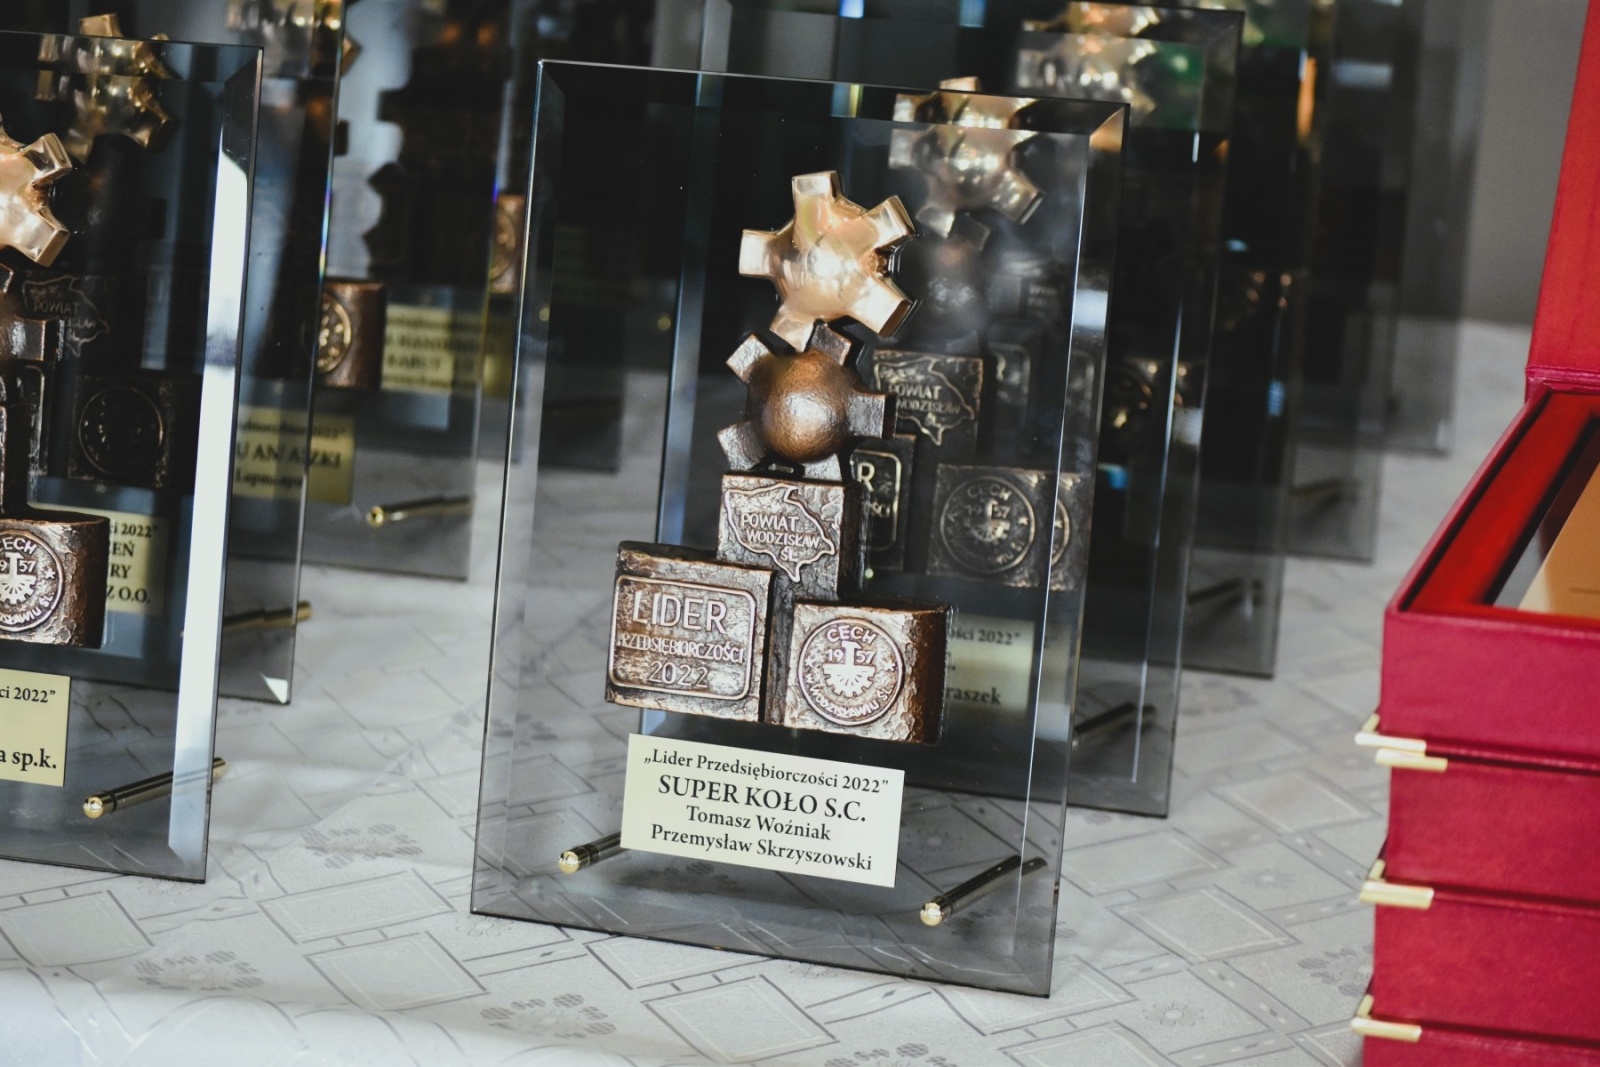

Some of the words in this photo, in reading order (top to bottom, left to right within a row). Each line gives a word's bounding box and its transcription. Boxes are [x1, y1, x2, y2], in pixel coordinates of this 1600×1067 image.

[740, 513, 800, 532] POWIAT
[746, 529, 821, 549] WODZISŁAW
[632, 590, 728, 635] LIDER
[826, 624, 878, 646] CECH
[649, 660, 709, 688] 2022
[11, 747, 57, 772] sp.k.
[643, 748, 694, 769] „Lider
[697, 754, 839, 788] Przedsiębiorczości
[842, 774, 889, 794] 2022”
[658, 773, 739, 805] SUPER
[744, 785, 819, 816] KOŁO
[823, 798, 867, 822] S.C.
[686, 804, 751, 830] Tomasz
[755, 814, 832, 842] Woźniak
[651, 823, 753, 853] Przemysław
[756, 838, 873, 872] Skrzyszowski
